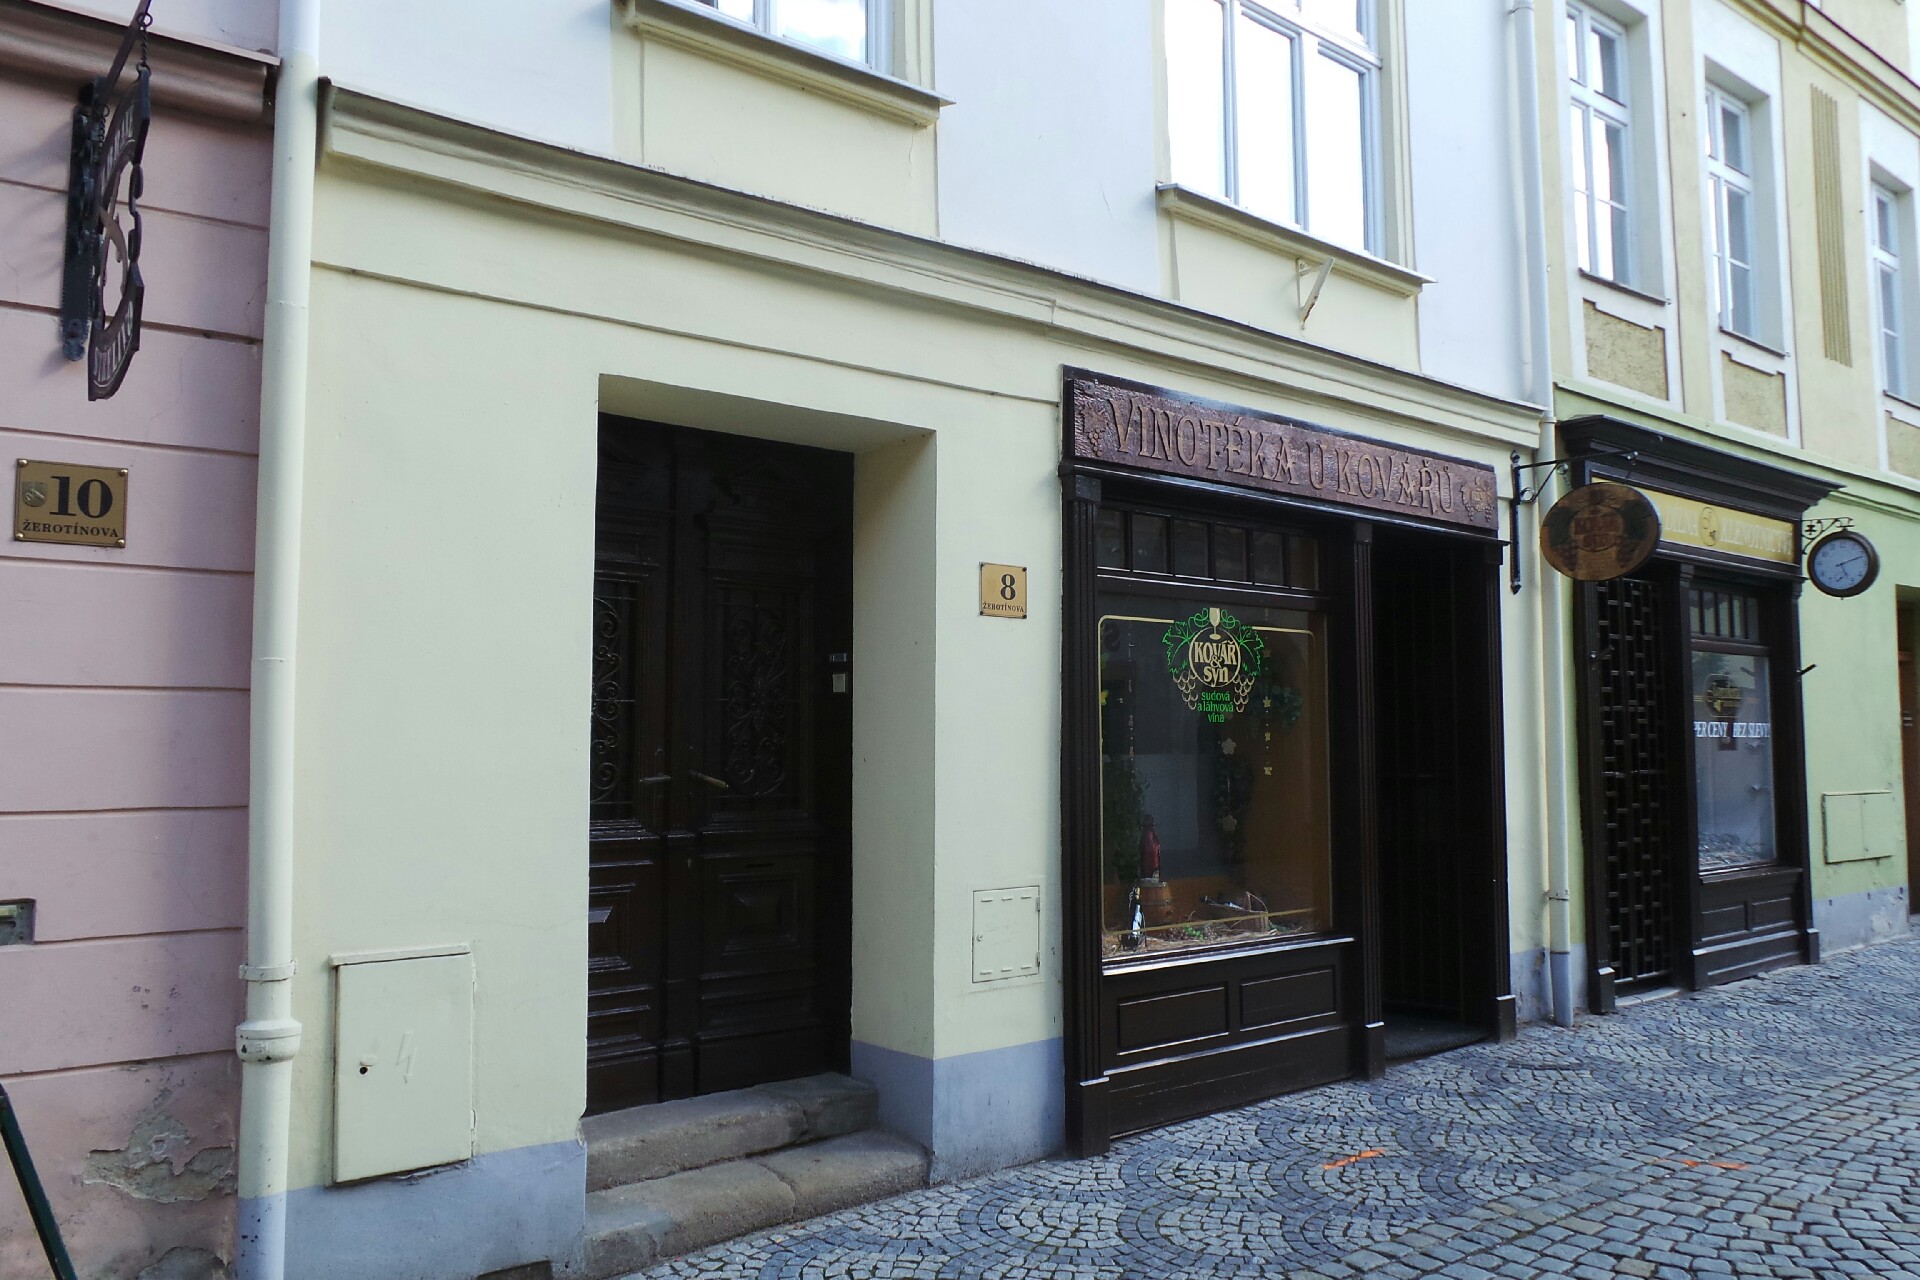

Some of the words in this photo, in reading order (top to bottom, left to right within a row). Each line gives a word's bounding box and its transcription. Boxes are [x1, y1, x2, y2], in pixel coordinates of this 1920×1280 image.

[1107, 399, 1299, 486] VINOTÉKA
[1306, 441, 1328, 490] U
[1335, 449, 1455, 515] KOVÁŘŮ
[49, 475, 113, 519] 10
[22, 519, 119, 538] ŽEROTÍNOVA
[1001, 574, 1016, 600] 8
[983, 602, 1024, 612] ŽEROTÍNOVA
[1194, 640, 1237, 665] KOVÁŘ
[1210, 654, 1223, 669] &
[1201, 690, 1230, 701] sudová
[1203, 701, 1234, 712] láhvová
[1207, 713, 1225, 723] vína
[1708, 721, 1729, 737] CENY
[1732, 722, 1747, 737] BEZ
